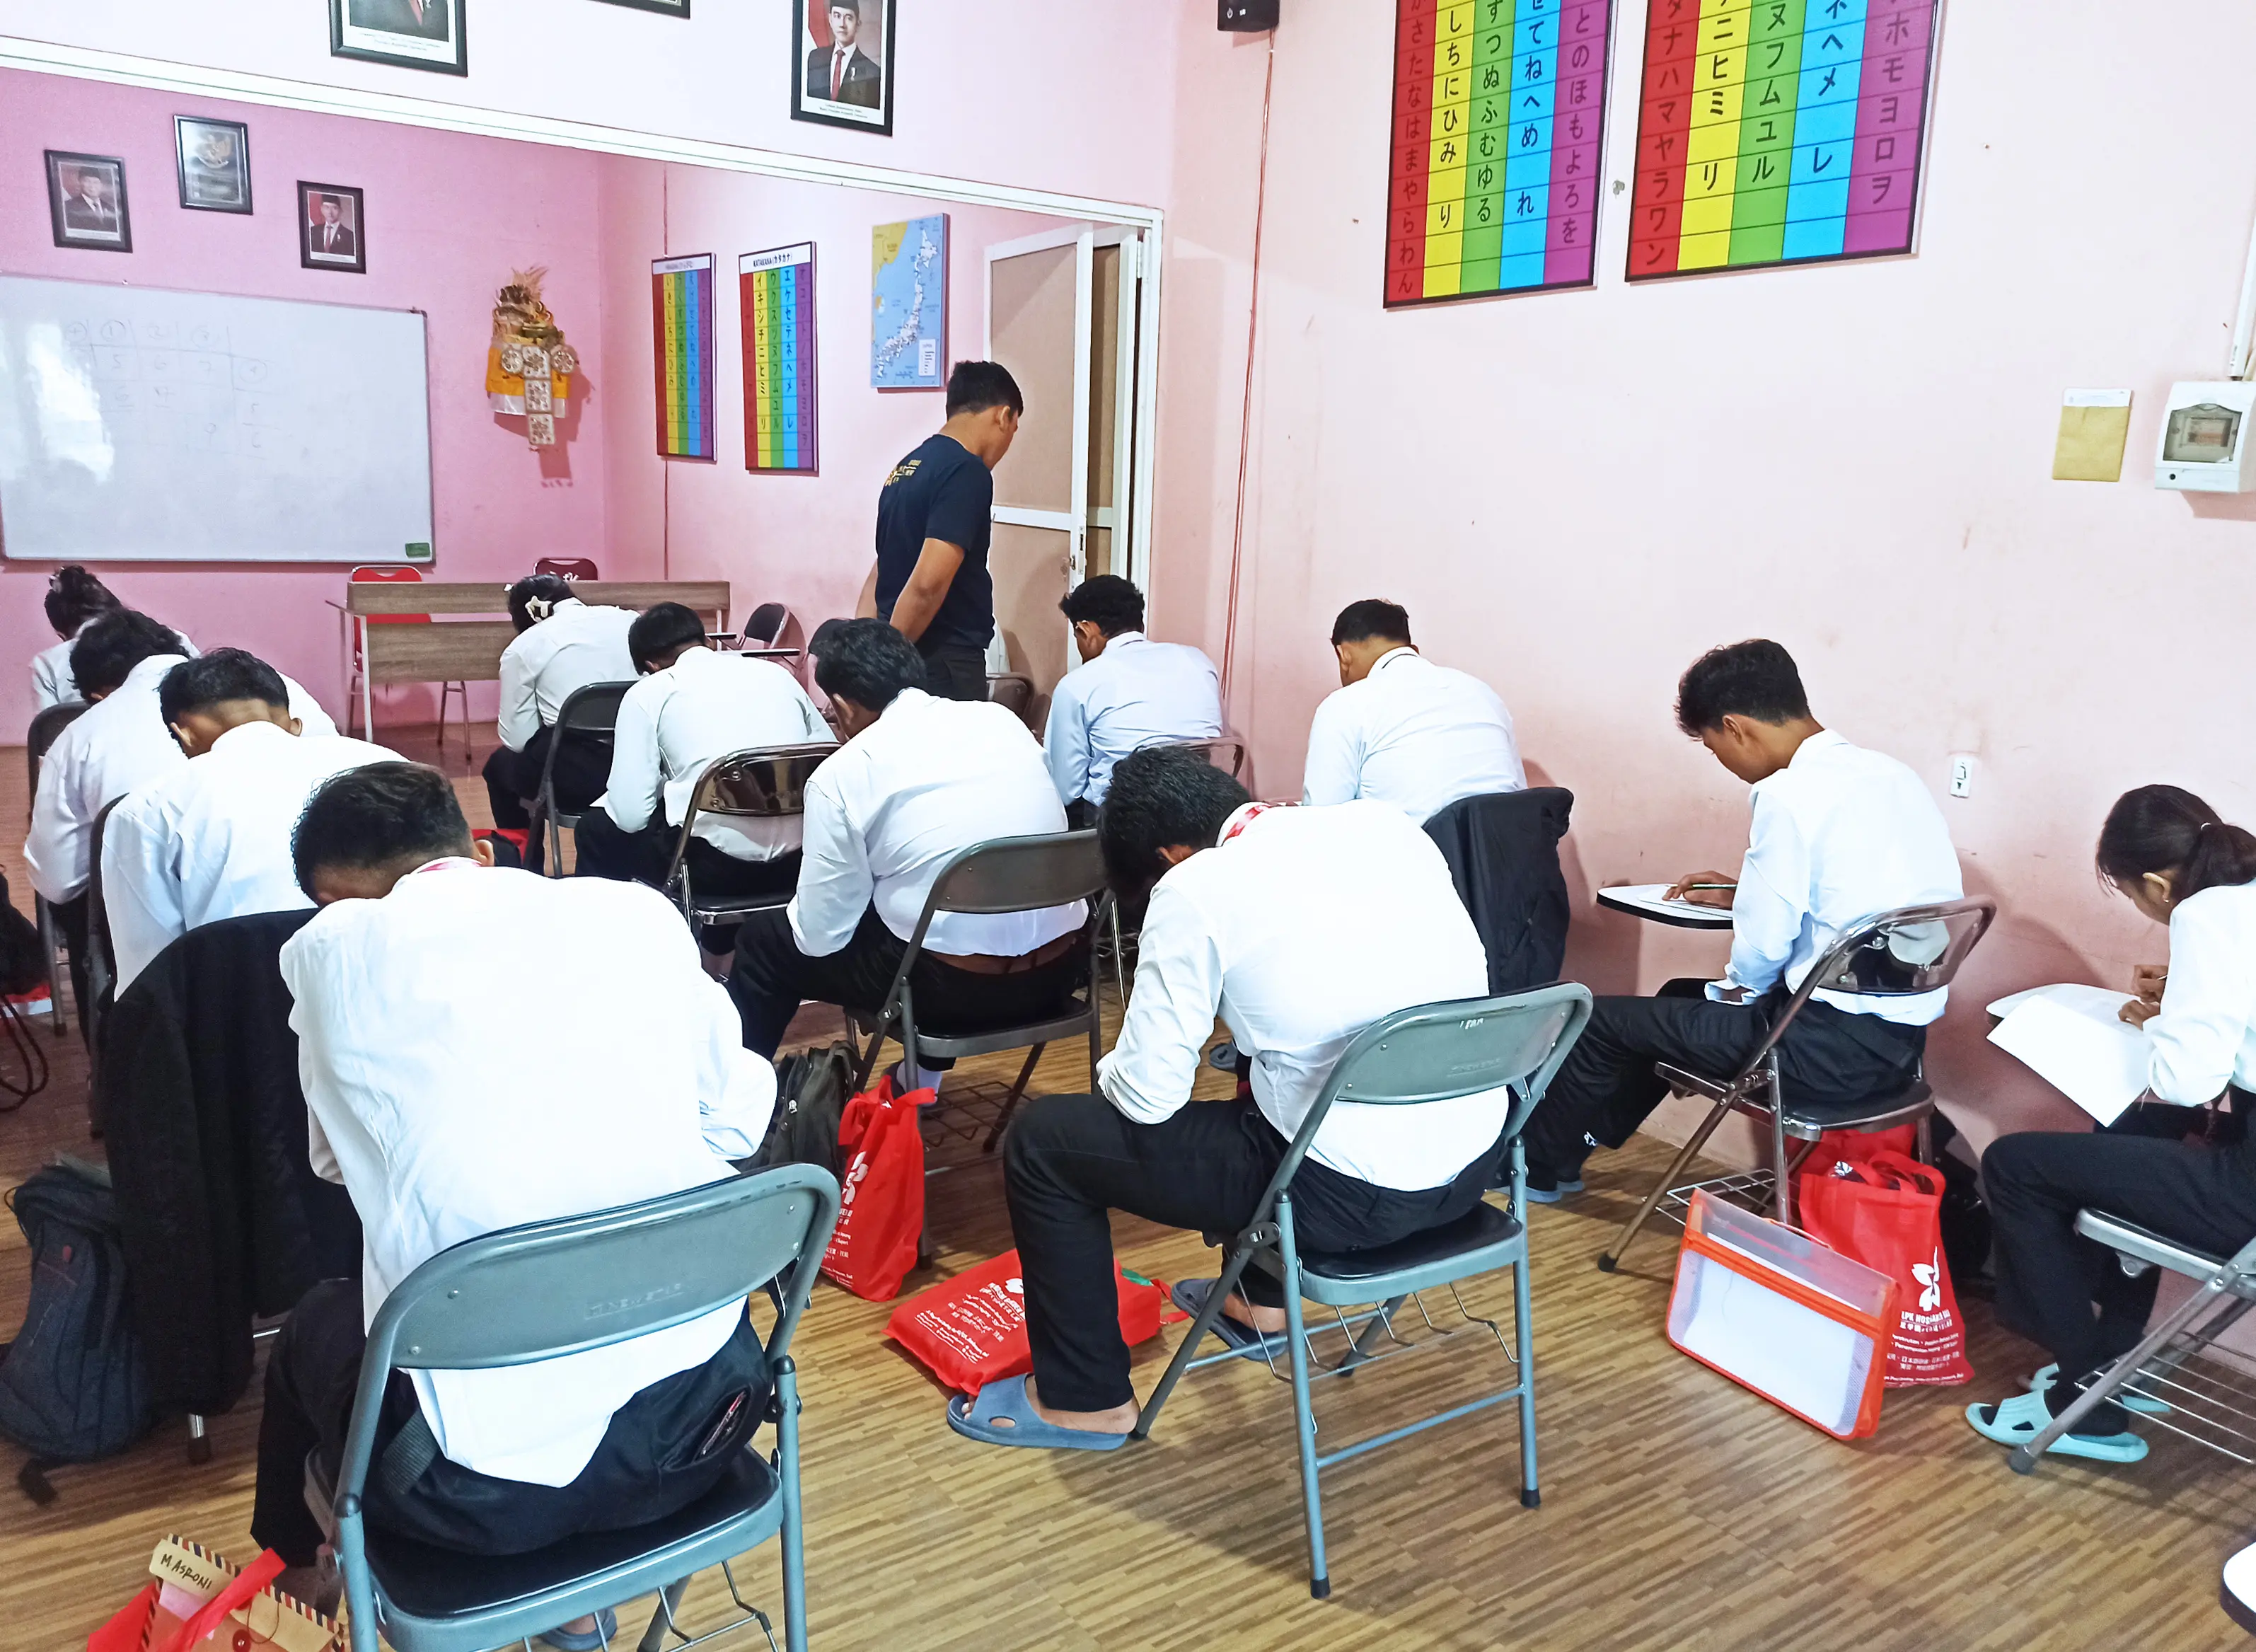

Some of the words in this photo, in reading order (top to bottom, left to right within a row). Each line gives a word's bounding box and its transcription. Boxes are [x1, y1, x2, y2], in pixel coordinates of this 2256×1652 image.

[1409, 52, 1422, 75] た
[1447, 42, 1459, 66] ち
[1486, 35, 1500, 54] つ
[1529, 21, 1544, 44] て
[1576, 8, 1590, 33] と
[1412, 19, 1423, 43] さ
[1450, 11, 1462, 33] し
[1487, 0, 1503, 23] す
[1664, 27, 1682, 55] ナ
[1714, 18, 1733, 40] ニ
[1767, 4, 1786, 31] ヌ
[1660, 68, 1679, 88] ハ
[1713, 55, 1728, 79] ヒ
[1766, 42, 1784, 69] フ
[1885, 11, 1909, 45] ホ
[1408, 84, 1421, 108] な
[1445, 78, 1458, 99] に
[1483, 65, 1499, 89] ぬ
[1525, 55, 1541, 81] ね
[1572, 45, 1589, 68] の
[1658, 101, 1676, 123] マ
[1710, 91, 1723, 115] ミ
[1760, 79, 1780, 106] ム
[1819, 67, 1836, 96] メ
[1882, 57, 1904, 83] モ
[1406, 116, 1421, 139] は
[1444, 110, 1457, 132] ひ
[1481, 100, 1497, 123] ふ
[1570, 79, 1587, 104] ほ
[1655, 137, 1673, 162] ヤ
[1756, 121, 1776, 142] ユ
[1880, 97, 1898, 123] ヨ
[1406, 149, 1418, 171] ま
[1440, 141, 1456, 163] み
[1480, 133, 1496, 156] む
[1522, 123, 1537, 147] め
[1569, 114, 1583, 139] も
[1404, 180, 1417, 202] や
[1478, 164, 1492, 190] ゆ
[1566, 149, 1580, 174] よ
[1653, 171, 1668, 198] ラ
[1704, 163, 1718, 190] リ
[1752, 156, 1774, 183] ル
[1813, 147, 1832, 173] レ
[1875, 137, 1895, 162] ロ
[1404, 212, 1414, 233] ら
[1441, 204, 1450, 228] り
[1477, 198, 1490, 221] る
[1517, 191, 1534, 216] れ
[1565, 184, 1579, 208] ろ
[1650, 207, 1666, 232] ワ
[1873, 176, 1891, 204] ヲ
[1400, 242, 1414, 265] わ
[1563, 218, 1577, 243] を
[1647, 243, 1665, 265] ン
[758, 293, 763, 306] キ
[785, 289, 790, 302] ケ
[770, 271, 776, 285] ウ
[785, 270, 790, 281] エ
[1399, 273, 1413, 293] ん
[759, 329, 763, 341] チ
[786, 326, 792, 338] テ
[773, 310, 777, 320] ス
[785, 306, 790, 320] セ
[760, 348, 764, 357] ニ
[773, 364, 777, 375] フ
[761, 419, 765, 429] リ
